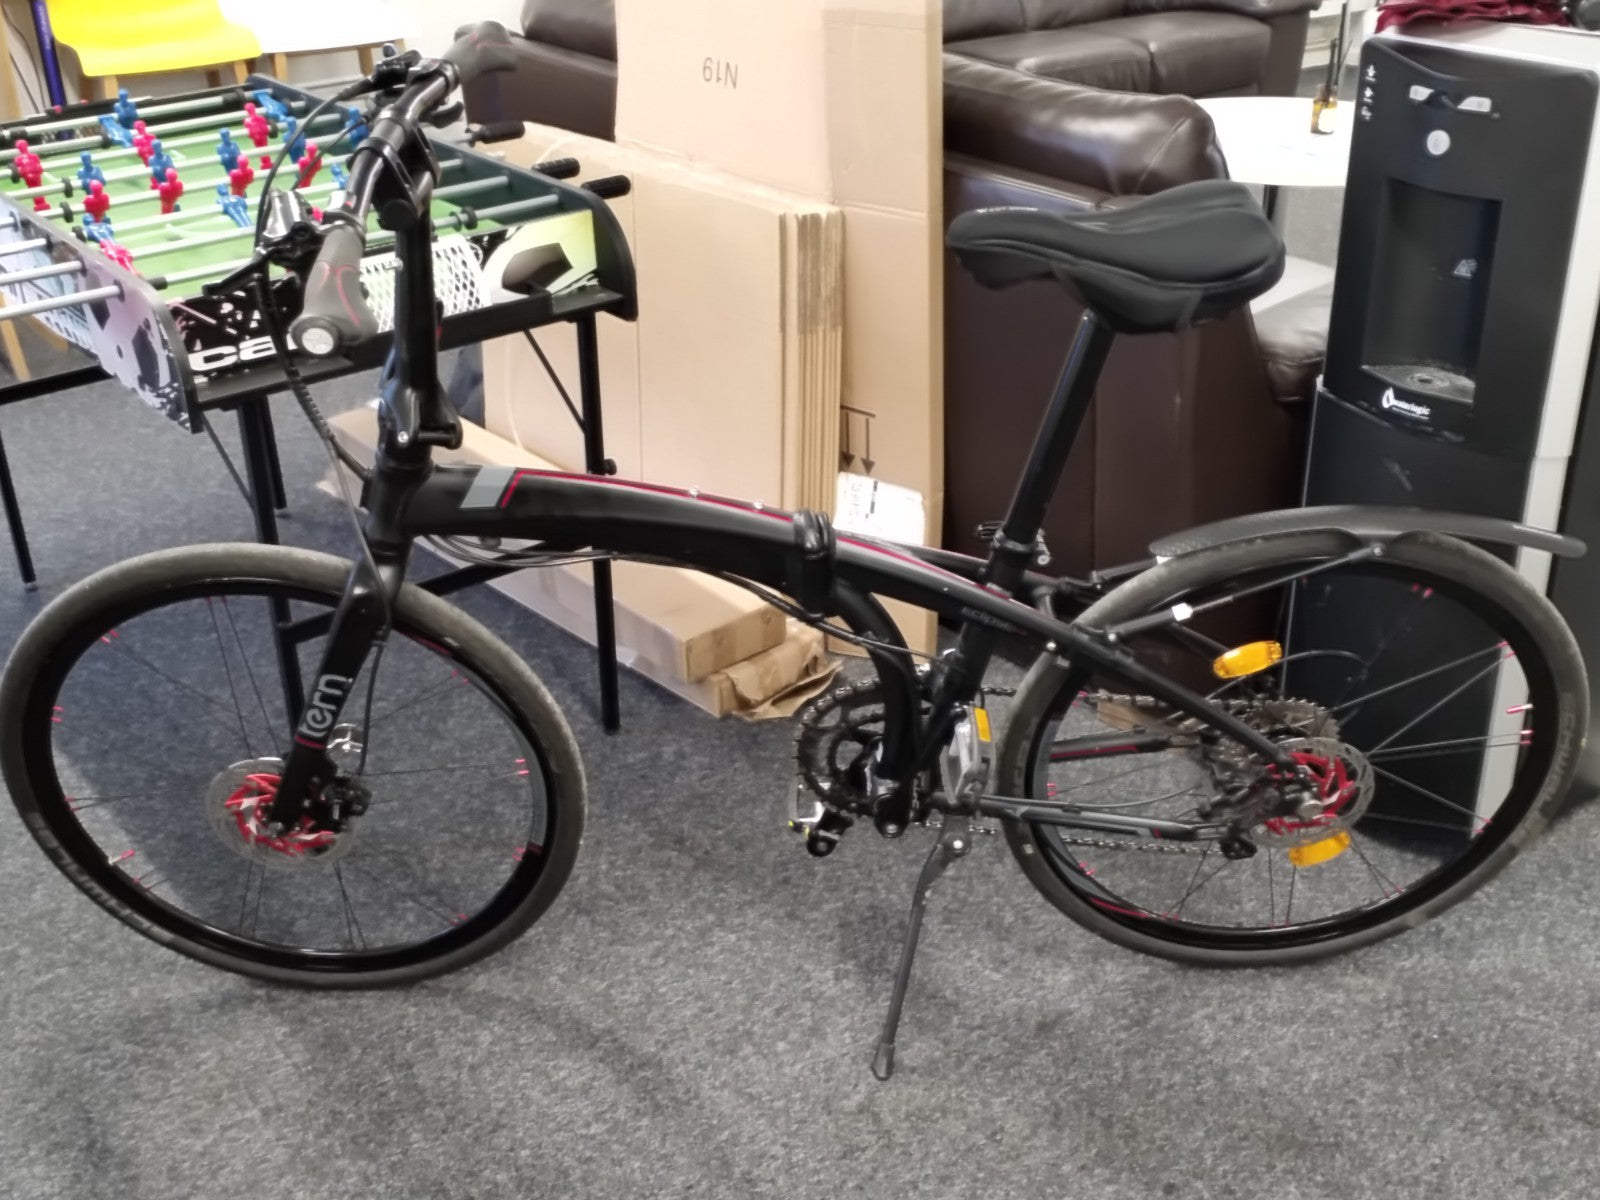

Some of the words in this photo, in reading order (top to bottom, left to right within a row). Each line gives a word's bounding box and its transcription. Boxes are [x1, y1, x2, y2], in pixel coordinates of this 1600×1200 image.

[702, 56, 739, 89] N19
[188, 335, 298, 371] ca
[298, 674, 353, 737] tern
